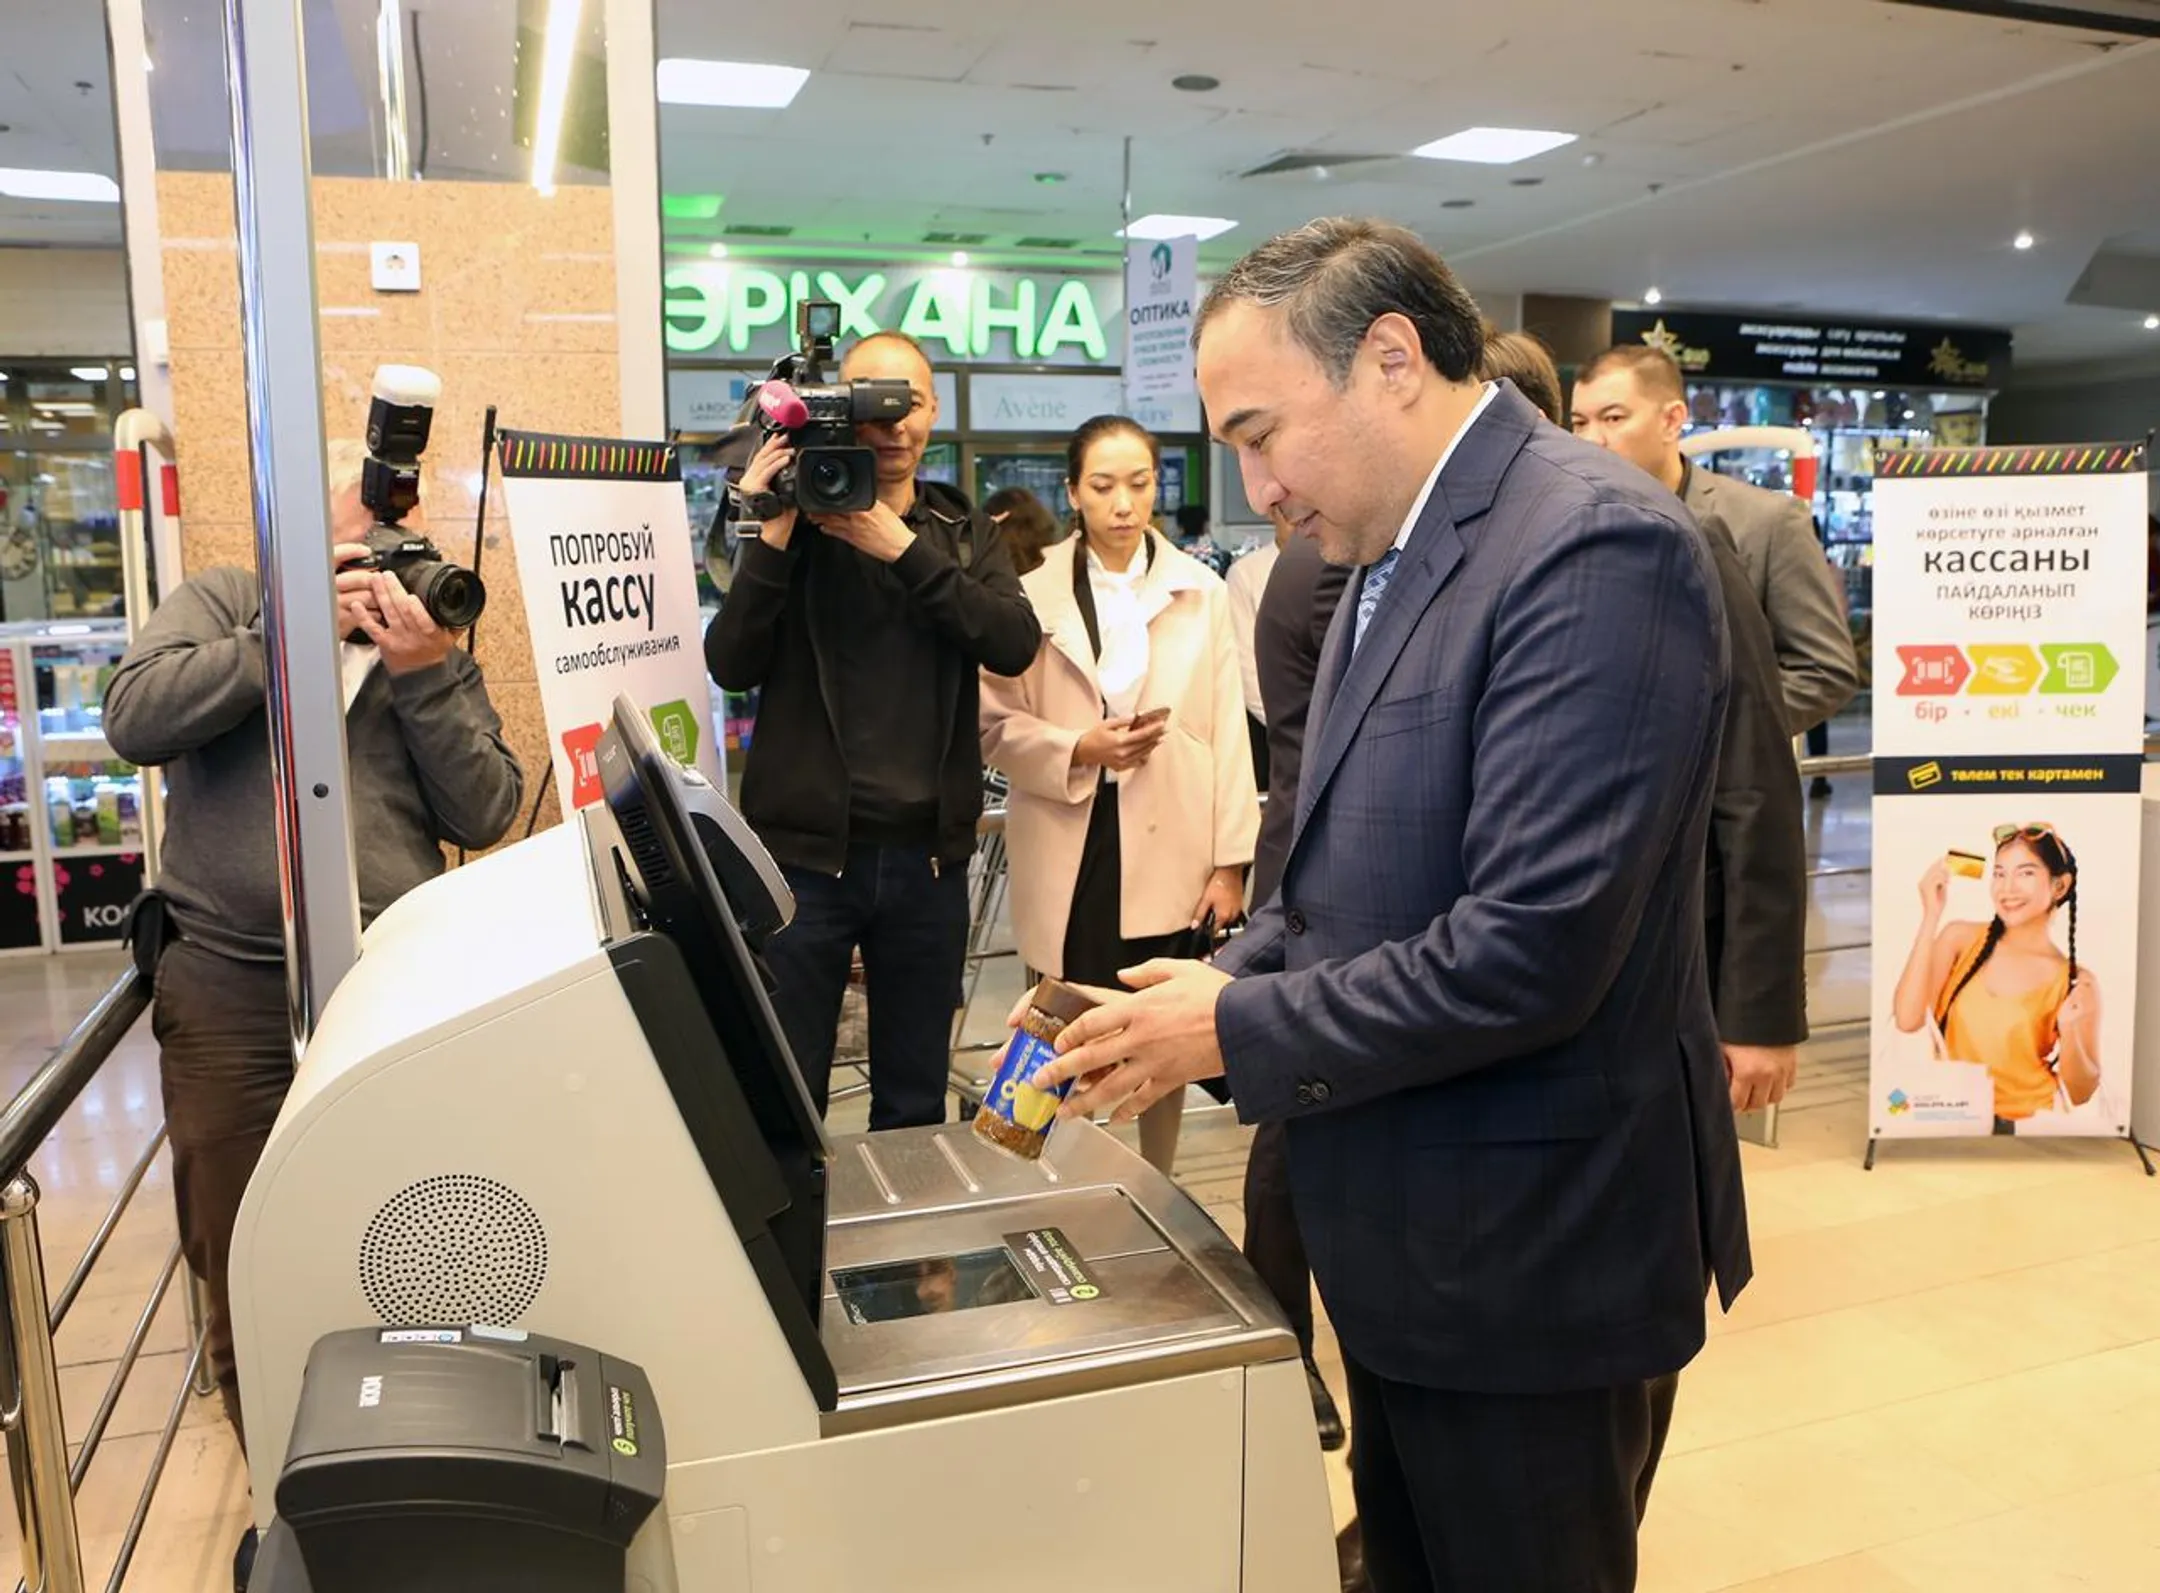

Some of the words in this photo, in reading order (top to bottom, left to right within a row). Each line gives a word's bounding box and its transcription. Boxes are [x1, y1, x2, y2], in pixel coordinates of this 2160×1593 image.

[1130, 300, 1190, 325] ОПТИКА
[994, 396, 1067, 420] Avène
[1928, 507, 1977, 519] өзіне
[549, 522, 656, 567] ПОПРОБУЙ
[1924, 548, 2090, 574] кассаны
[560, 572, 655, 632] кассу
[1937, 580, 2076, 601] ПАЙДАЛАНЫП
[1969, 605, 2043, 622] КӨРІҢІЗ
[555, 634, 681, 675] самообслуживания
[1915, 701, 1948, 723] бір
[1988, 702, 2019, 719] екі
[2056, 703, 2096, 718] чек
[2000, 769, 2025, 781] тек
[2028, 768, 2104, 783] картамен
